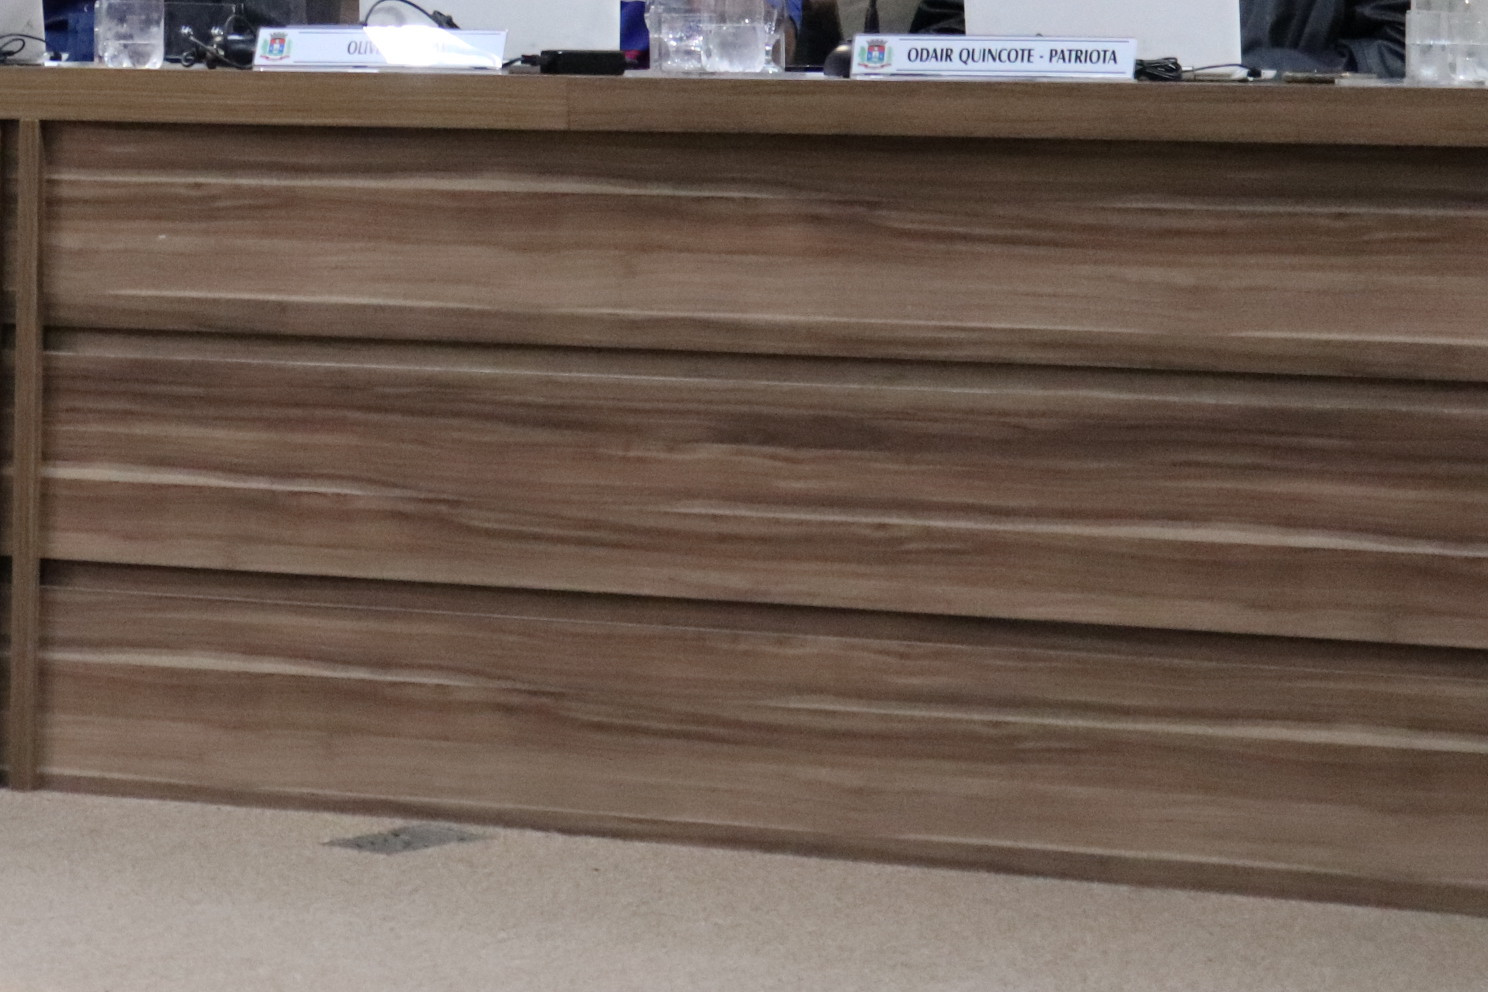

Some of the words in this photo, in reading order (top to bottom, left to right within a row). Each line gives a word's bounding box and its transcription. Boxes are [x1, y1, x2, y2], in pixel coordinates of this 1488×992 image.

[907, 47, 954, 63] ODAIR
[959, 48, 1034, 65] QUINCOTE
[1048, 49, 1118, 65] PATRIOTA
